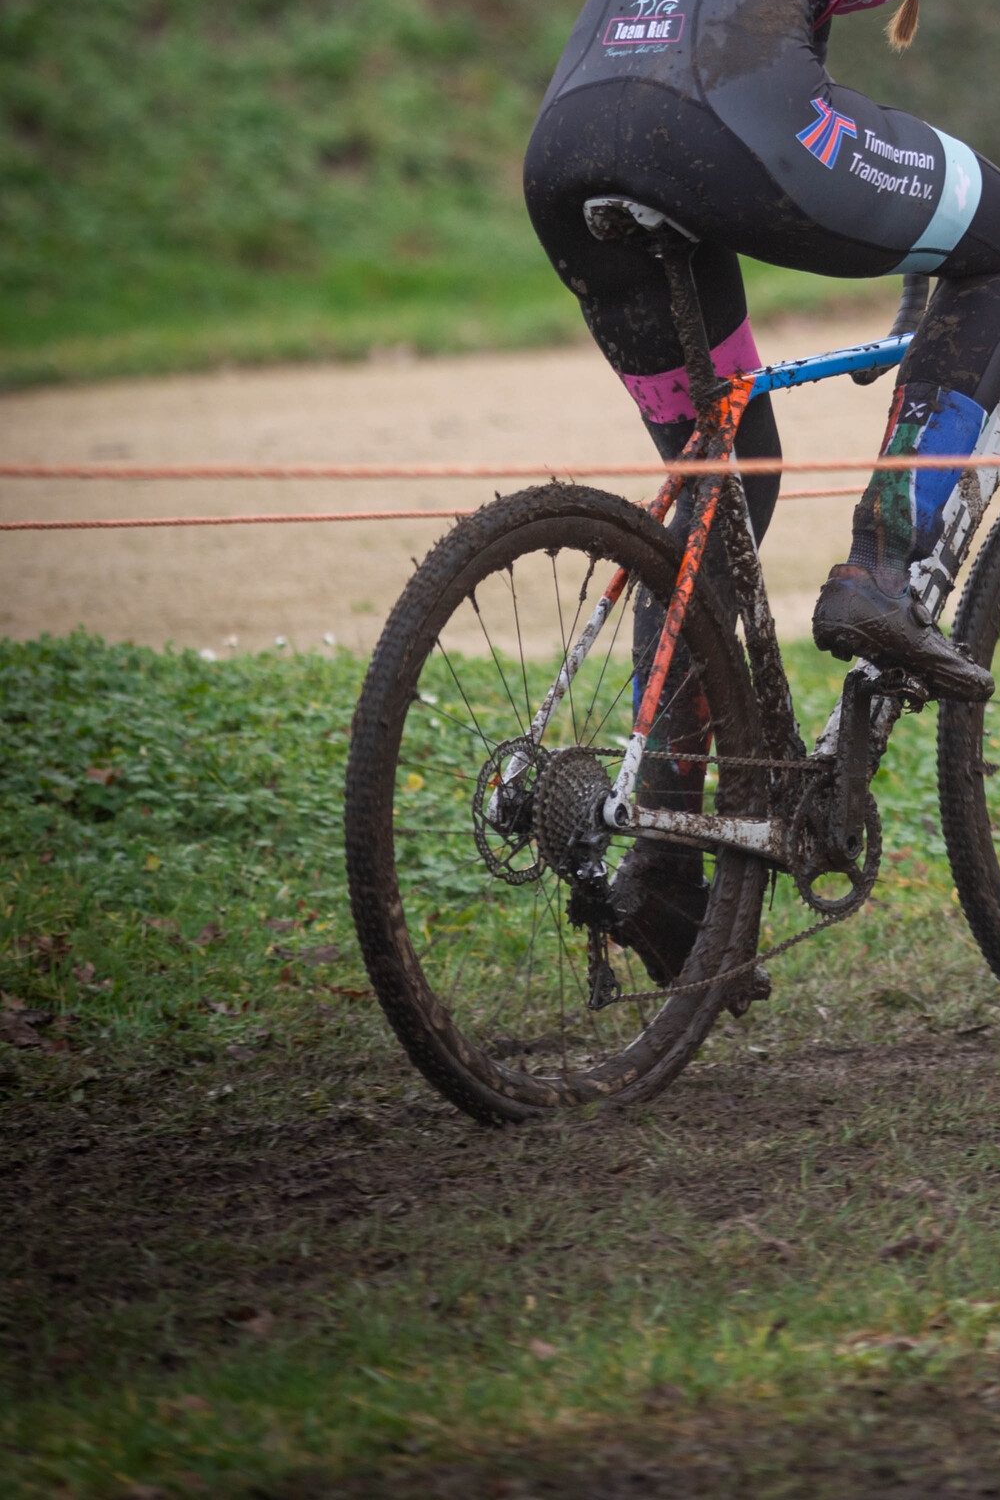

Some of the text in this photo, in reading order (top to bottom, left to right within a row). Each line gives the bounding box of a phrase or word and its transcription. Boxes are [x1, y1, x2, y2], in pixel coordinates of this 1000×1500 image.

[614, 22, 646, 40] Team
[864, 129, 935, 171] Timmerman
[849, 152, 934, 200] Transport b.v.
